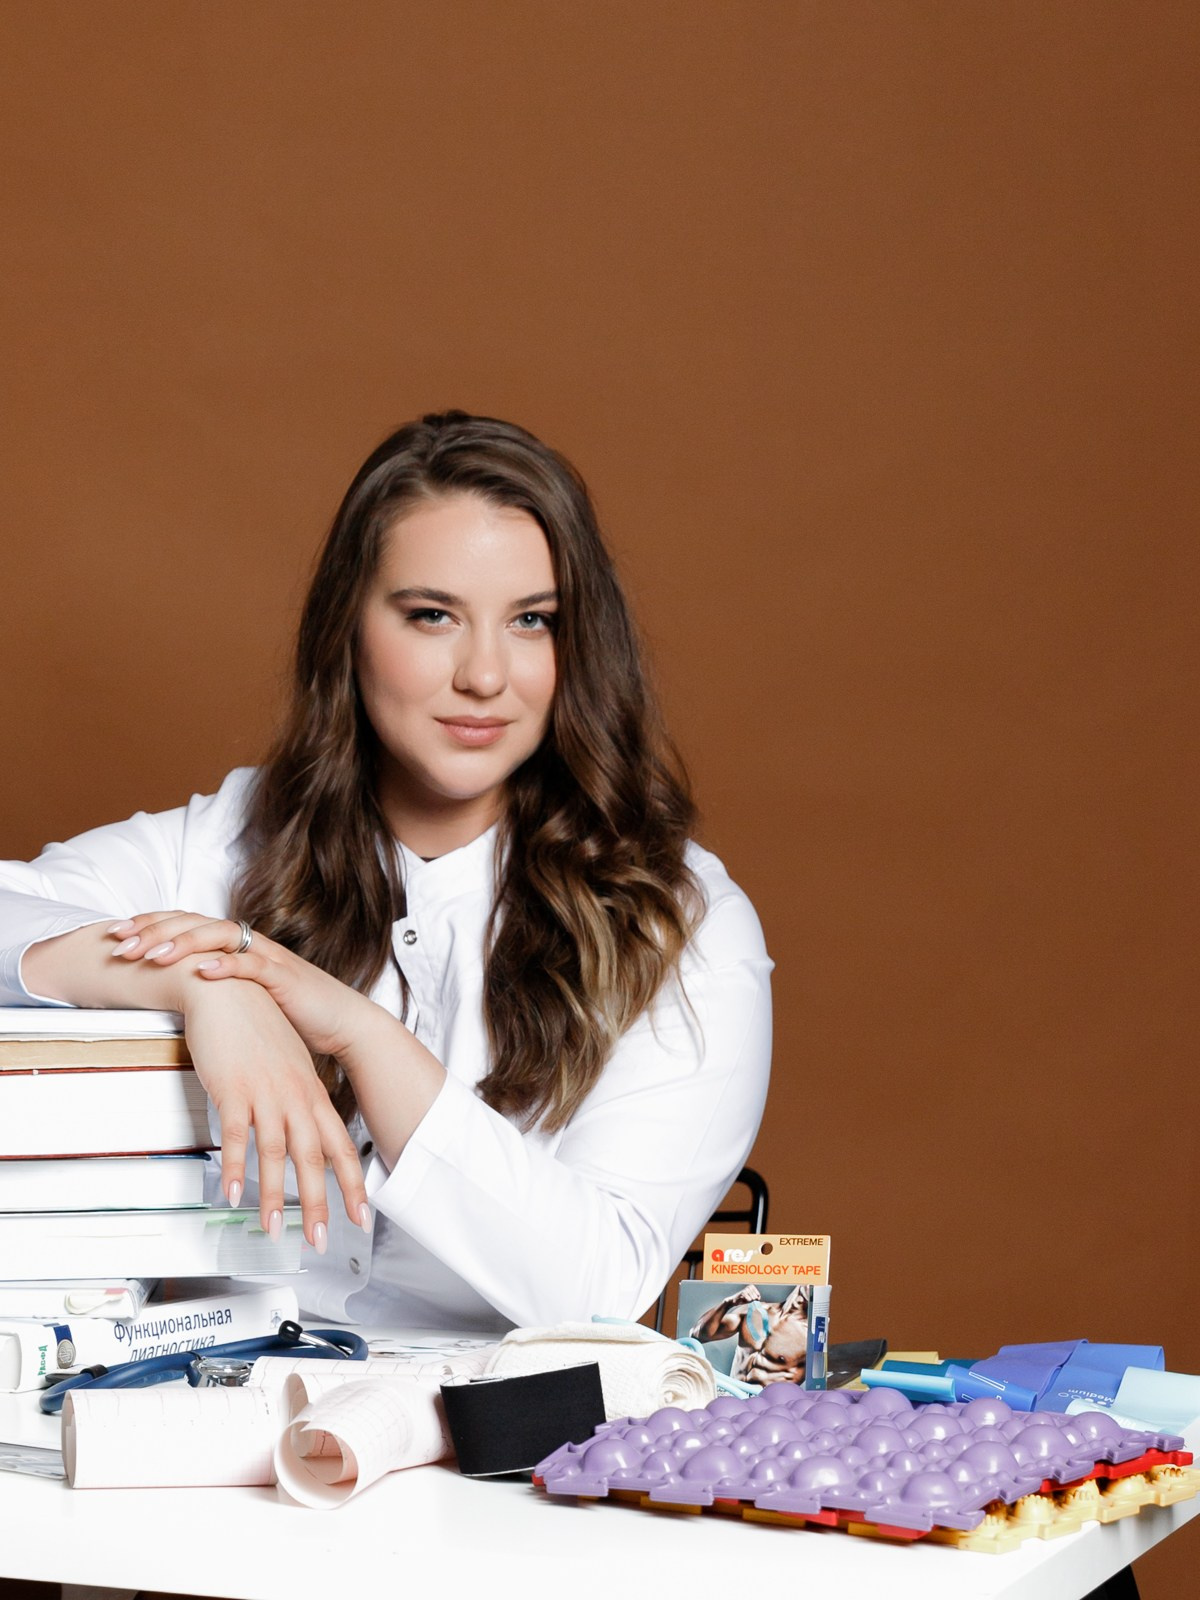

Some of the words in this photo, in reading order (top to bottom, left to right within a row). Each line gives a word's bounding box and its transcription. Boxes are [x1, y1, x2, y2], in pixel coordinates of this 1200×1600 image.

[779, 1237, 824, 1246] EXTREME
[711, 1248, 755, 1263] ares
[711, 1264, 789, 1275] KINESIOLOGY
[792, 1265, 821, 1275] TAPE
[113, 1308, 233, 1347] Функциональная
[1067, 1389, 1115, 1403] Medium
